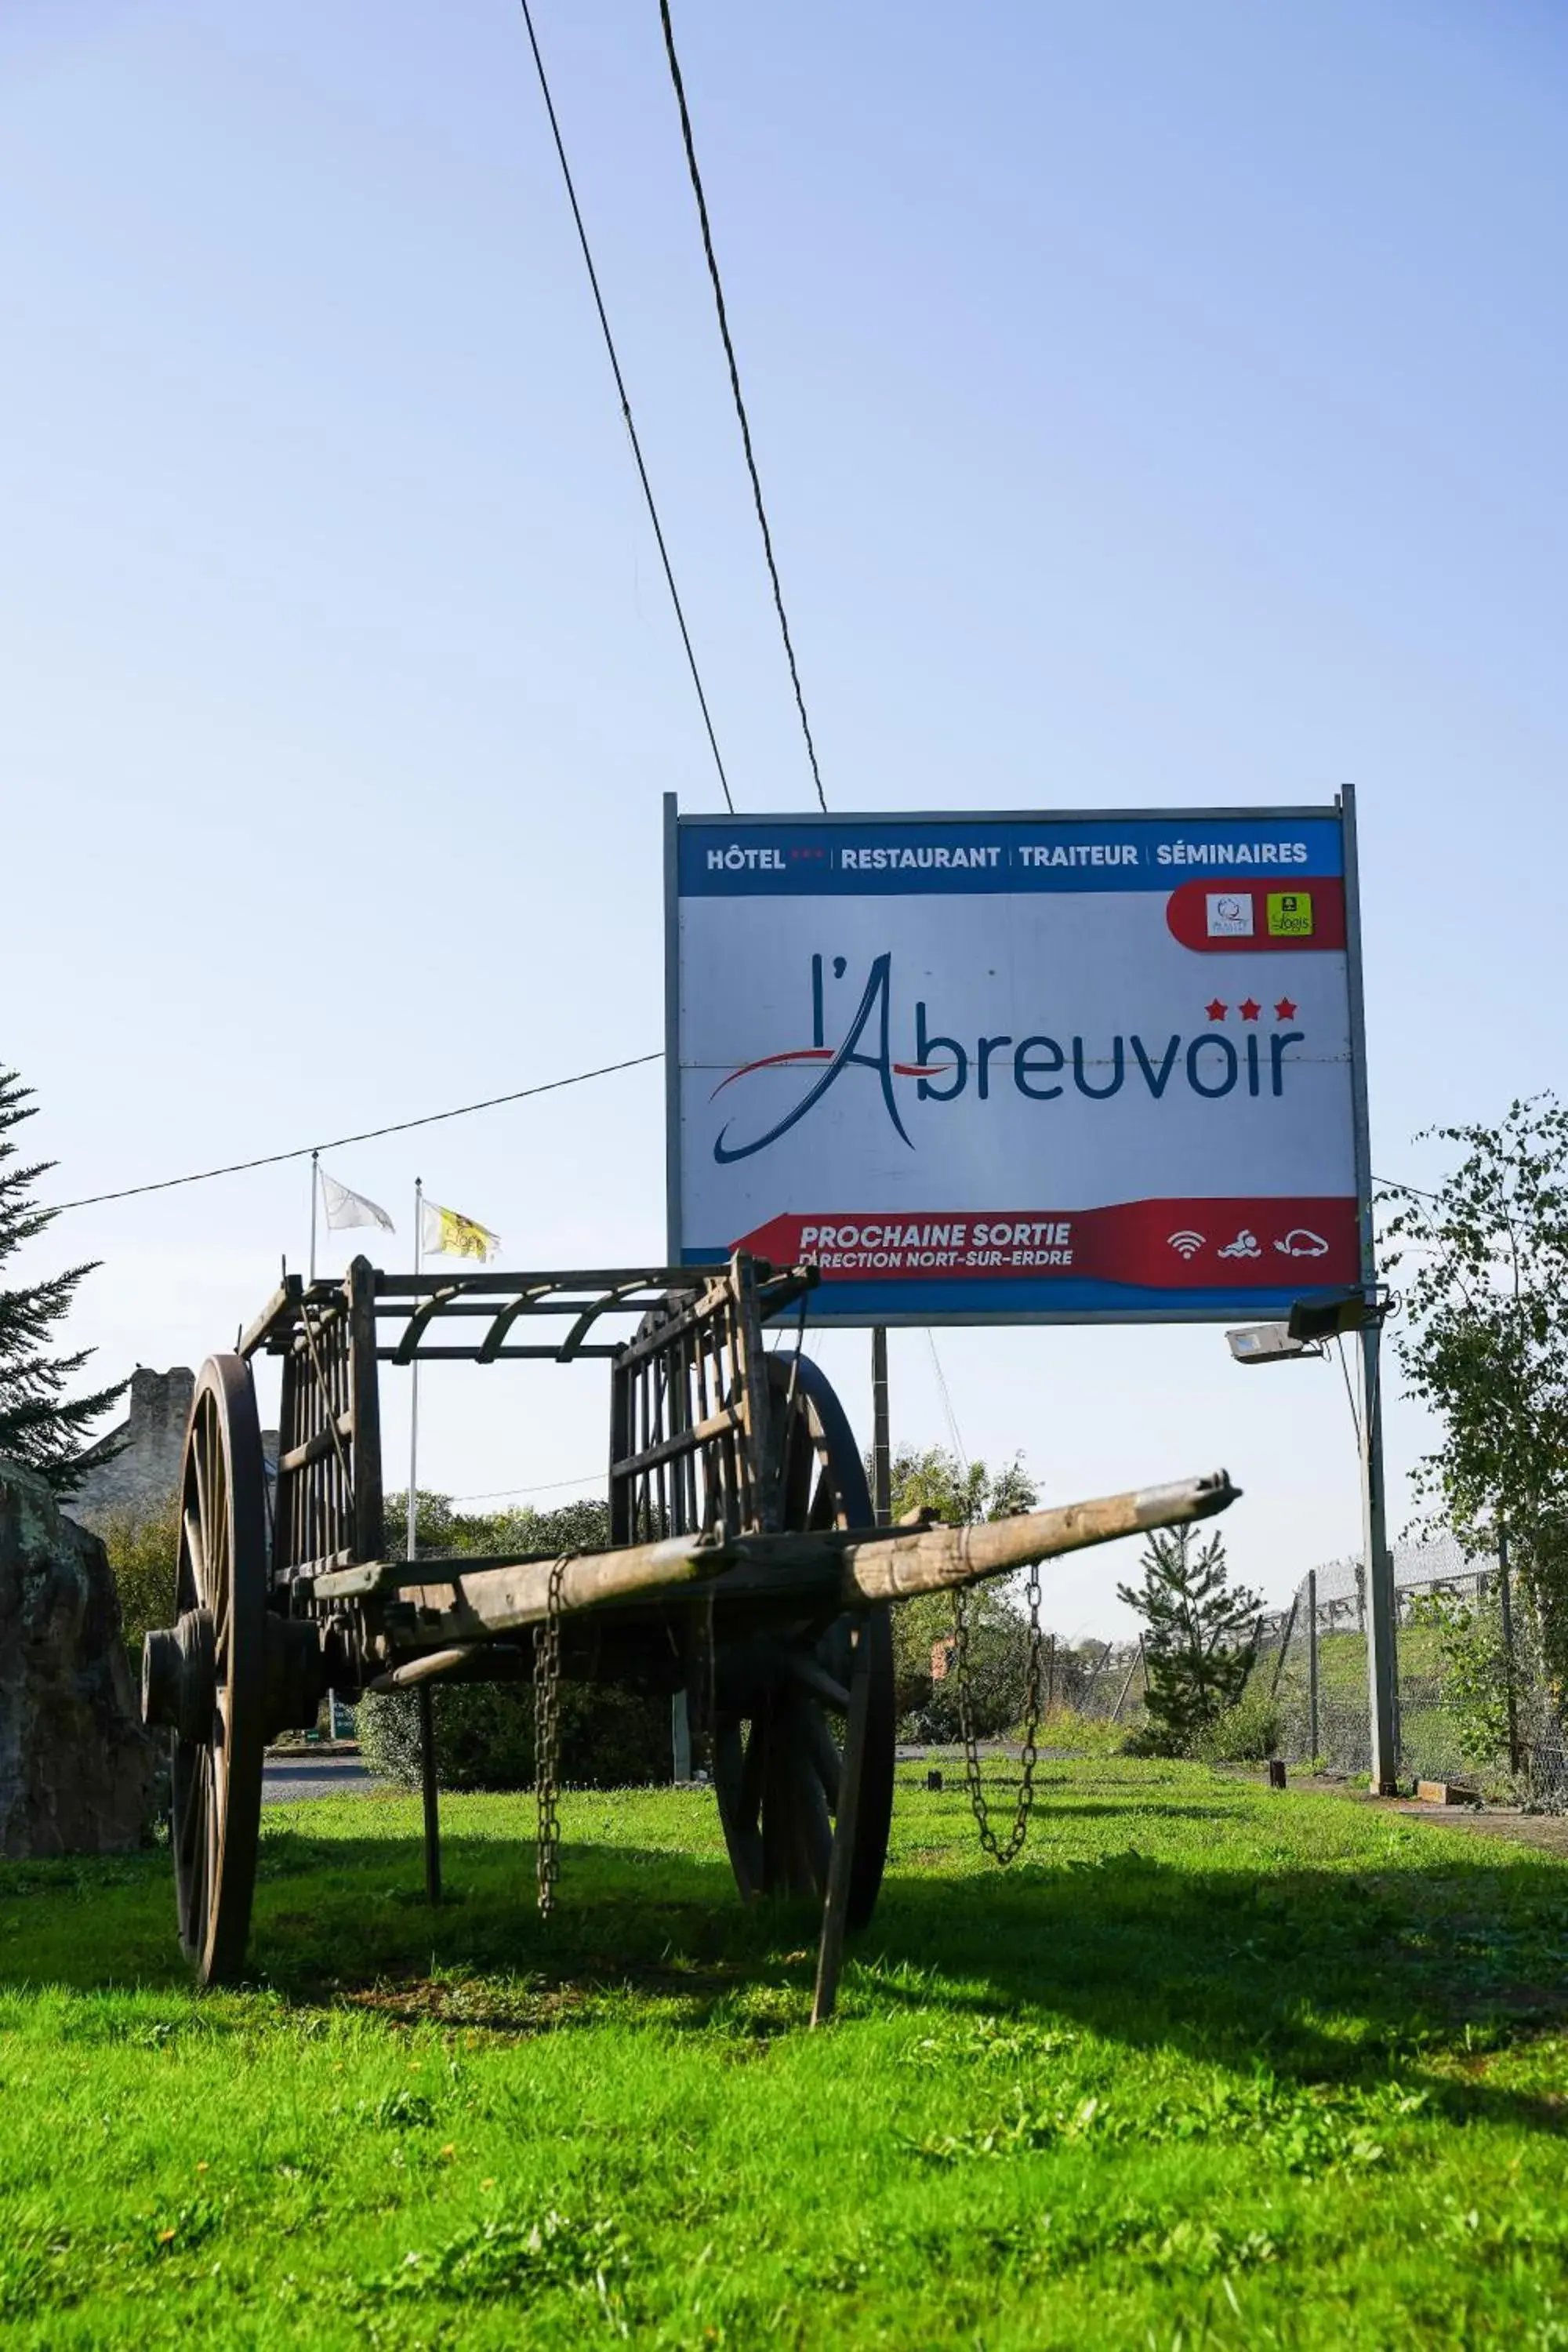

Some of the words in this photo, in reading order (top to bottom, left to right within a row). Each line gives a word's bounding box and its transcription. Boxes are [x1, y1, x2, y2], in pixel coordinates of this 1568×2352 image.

[706, 844, 786, 869] HÔTEL
[841, 847, 1000, 869] RESTAURANT
[1018, 844, 1138, 866] TRAITEUR
[1156, 840, 1308, 864] SÉMINAIRES
[800, 1224, 966, 1248] PROCHAINE
[972, 1222, 1071, 1247] SORTIE
[906, 1250, 1073, 1267] NORT-SUR-ERDRE
